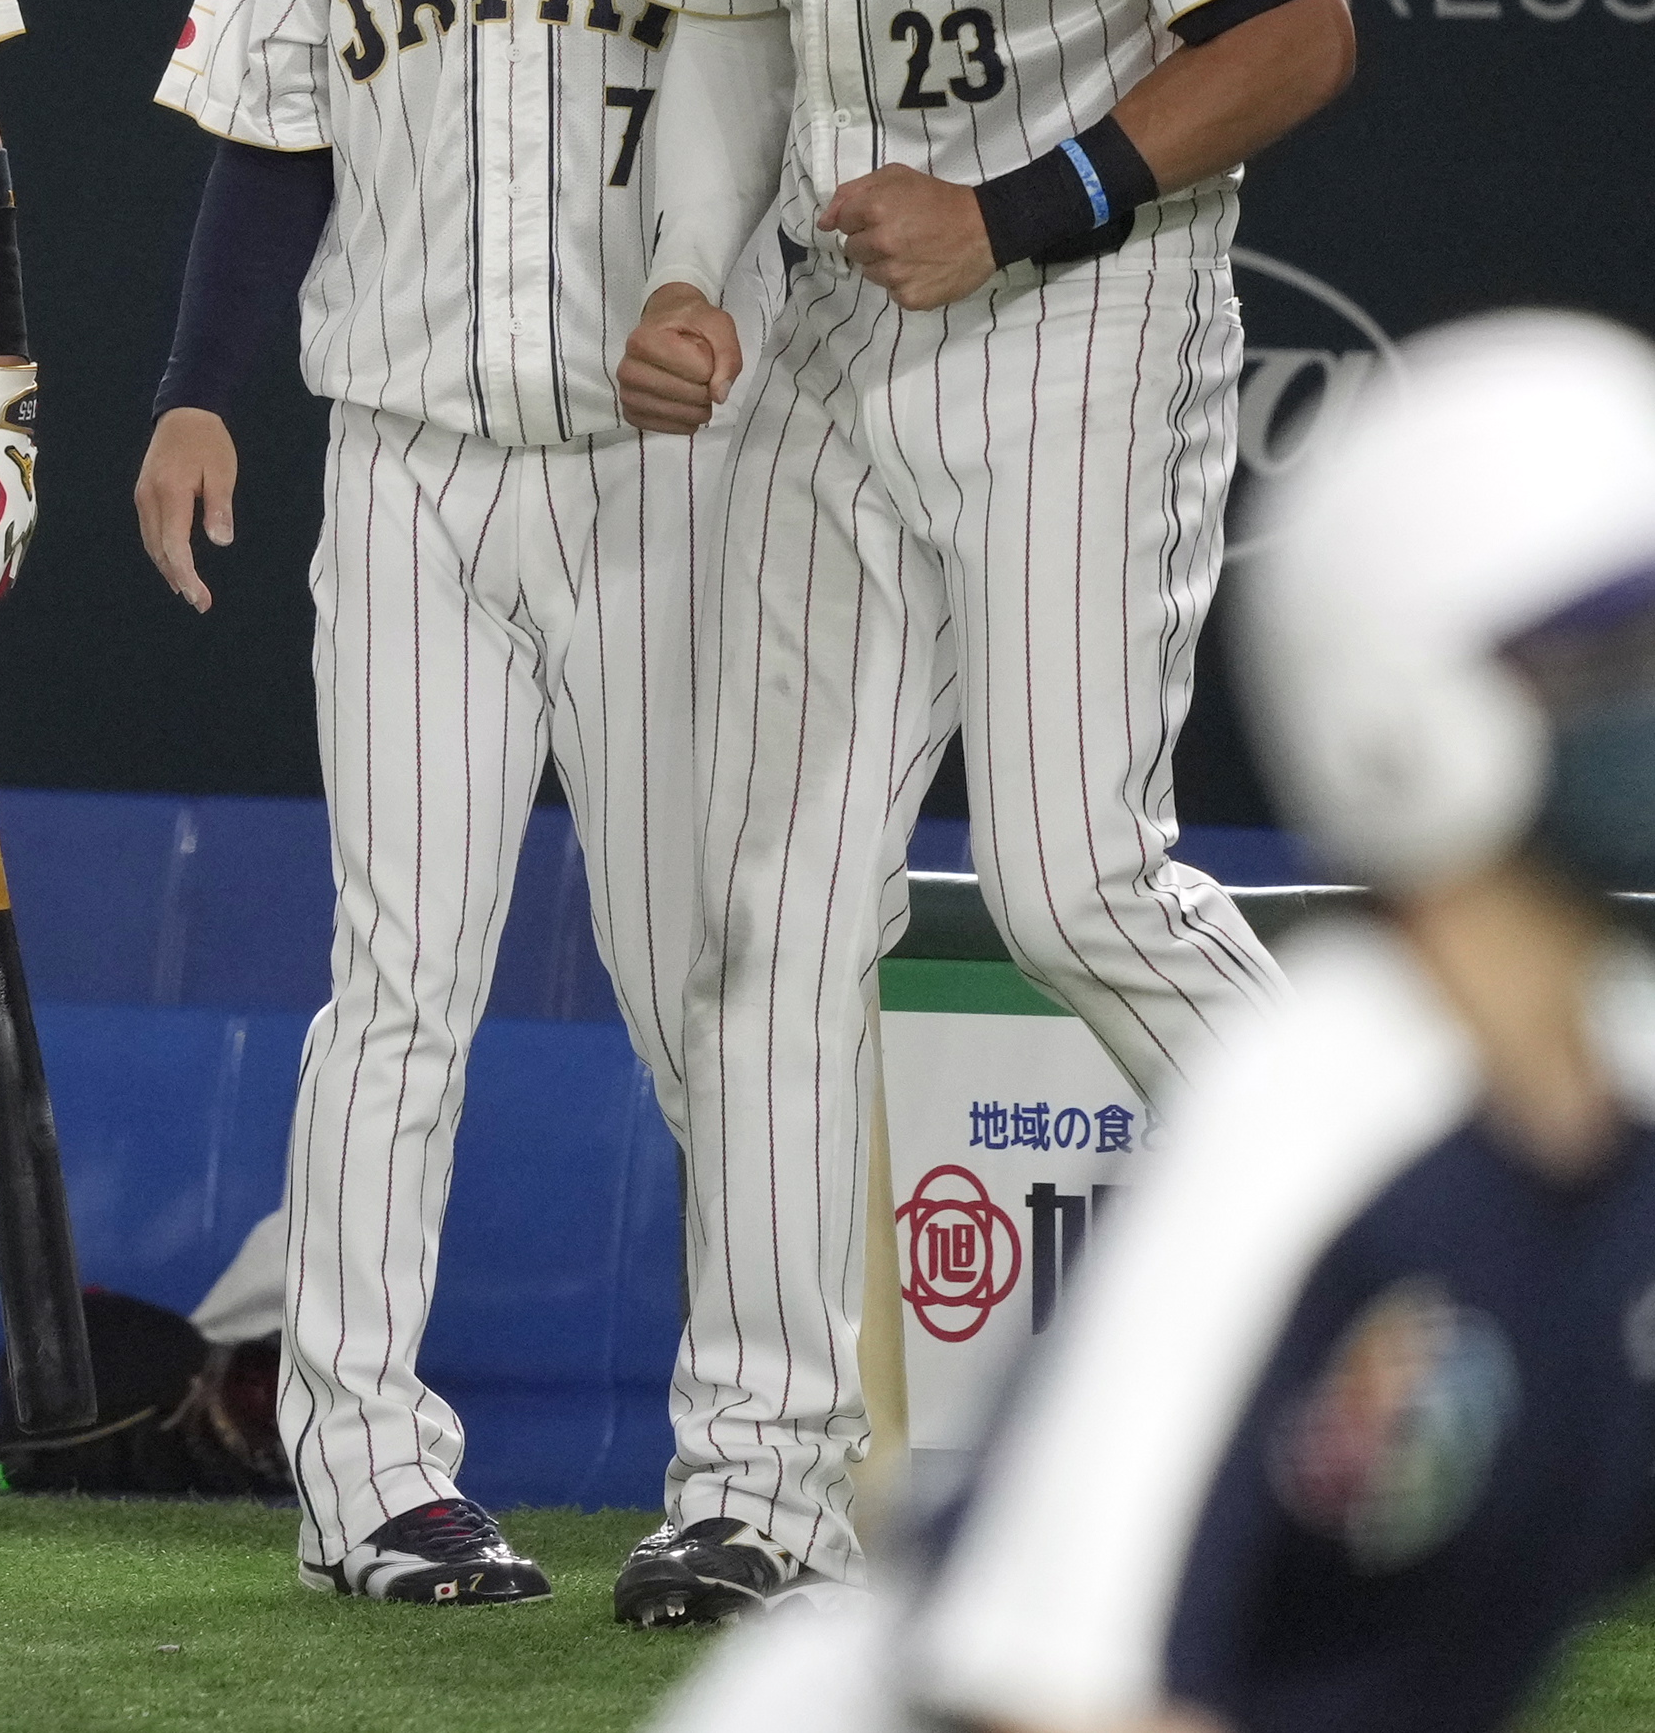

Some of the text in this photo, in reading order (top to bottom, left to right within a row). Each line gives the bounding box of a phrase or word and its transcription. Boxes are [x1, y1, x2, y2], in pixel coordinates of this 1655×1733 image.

[890, 7, 1007, 111] 23
[605, 86, 655, 188] 7
[924, 1221, 978, 1284] 旭
